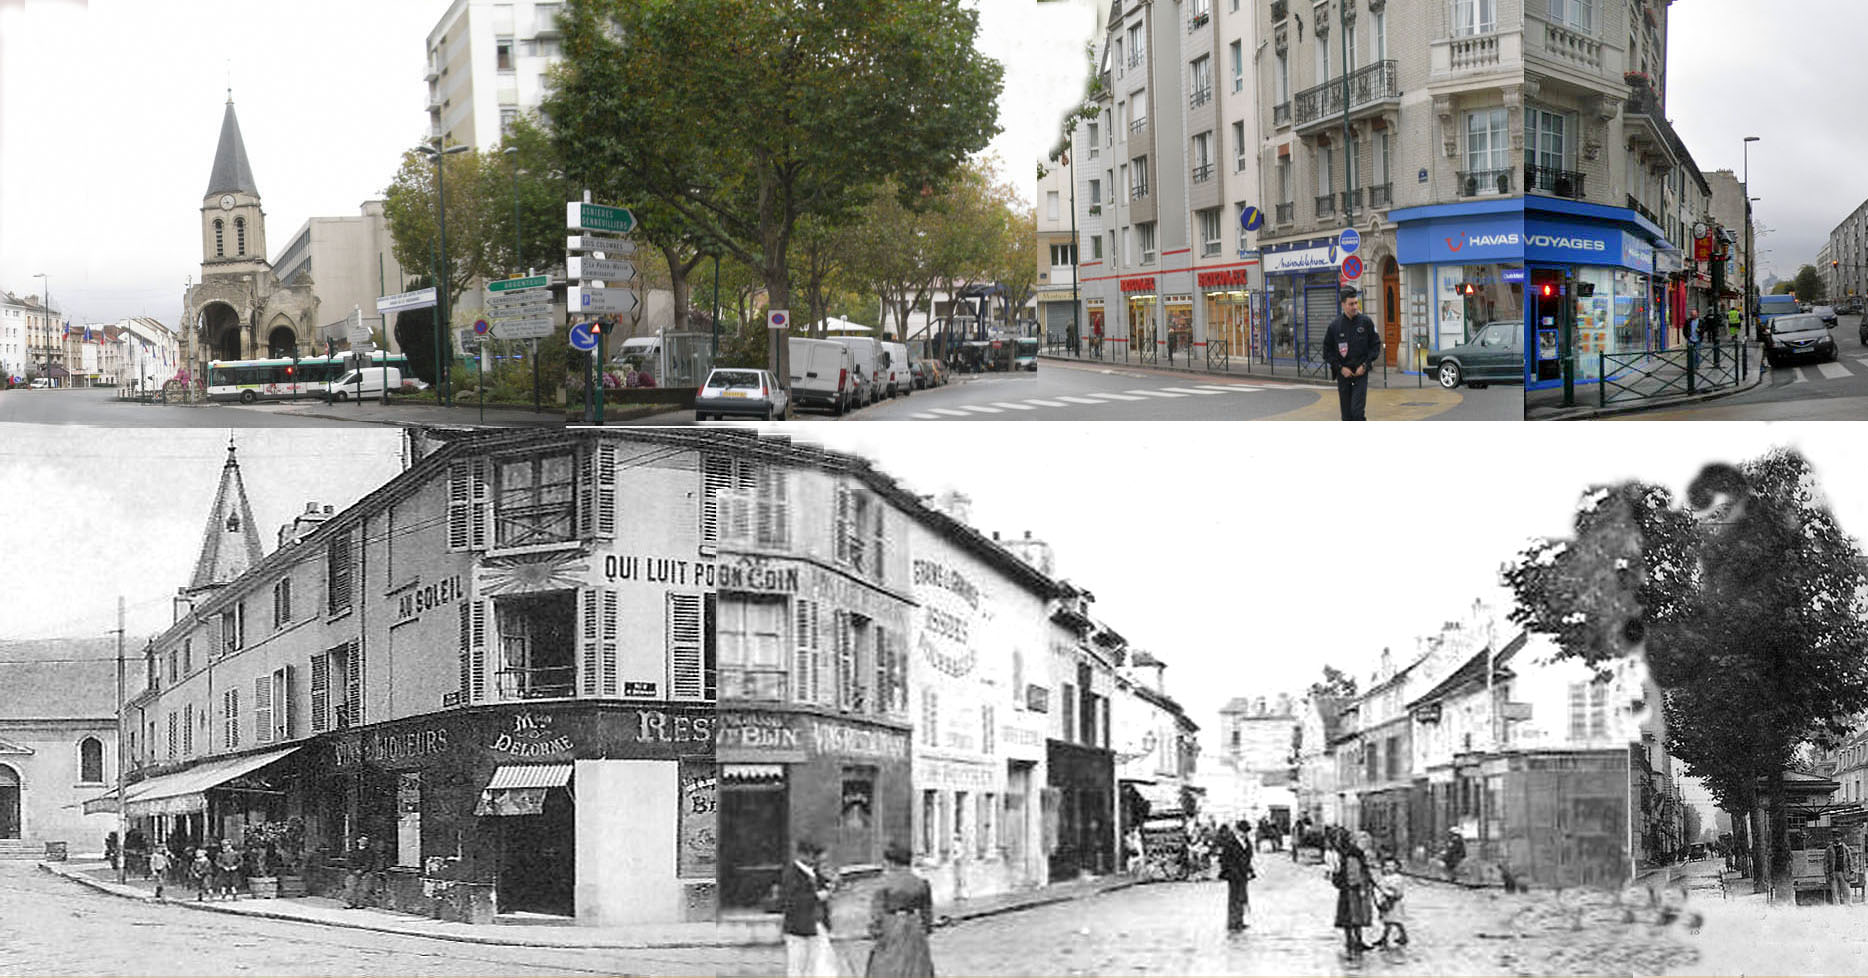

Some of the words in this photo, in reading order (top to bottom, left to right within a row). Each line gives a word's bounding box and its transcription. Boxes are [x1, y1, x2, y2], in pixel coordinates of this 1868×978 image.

[1469, 233, 1519, 246] HAVAS
[1524, 234, 1605, 250] VOYAGES
[605, 554, 638, 582] QUI
[647, 558, 688, 585] LUIT
[400, 597, 412, 618] AU
[416, 574, 464, 613] SOLEIL
[489, 733, 574, 757] DELORME
